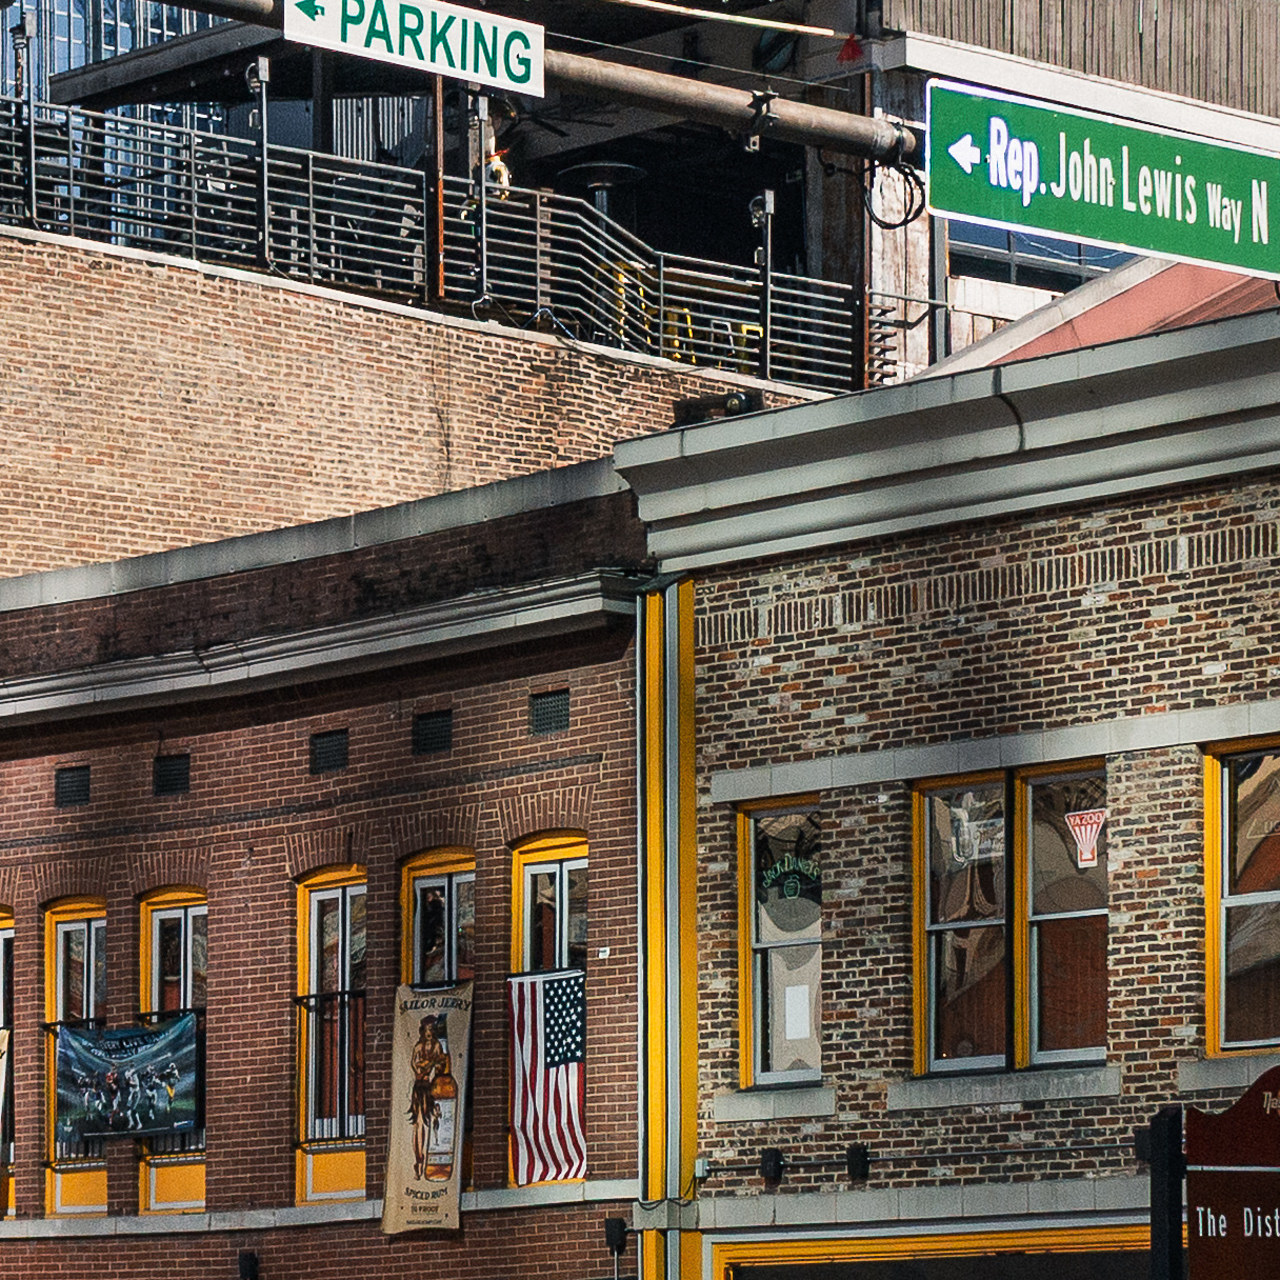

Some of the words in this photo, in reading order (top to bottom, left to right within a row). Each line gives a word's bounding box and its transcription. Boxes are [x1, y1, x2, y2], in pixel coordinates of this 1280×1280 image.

[988, 116, 1047, 207] Rep.
[1051, 131, 1115, 208] John
[1122, 145, 1197, 224] Lewis
[1207, 181, 1243, 244] Way
[1251, 178, 1269, 245] N
[1068, 812, 1105, 826] YAZOO
[1196, 1205, 1227, 1238] The
